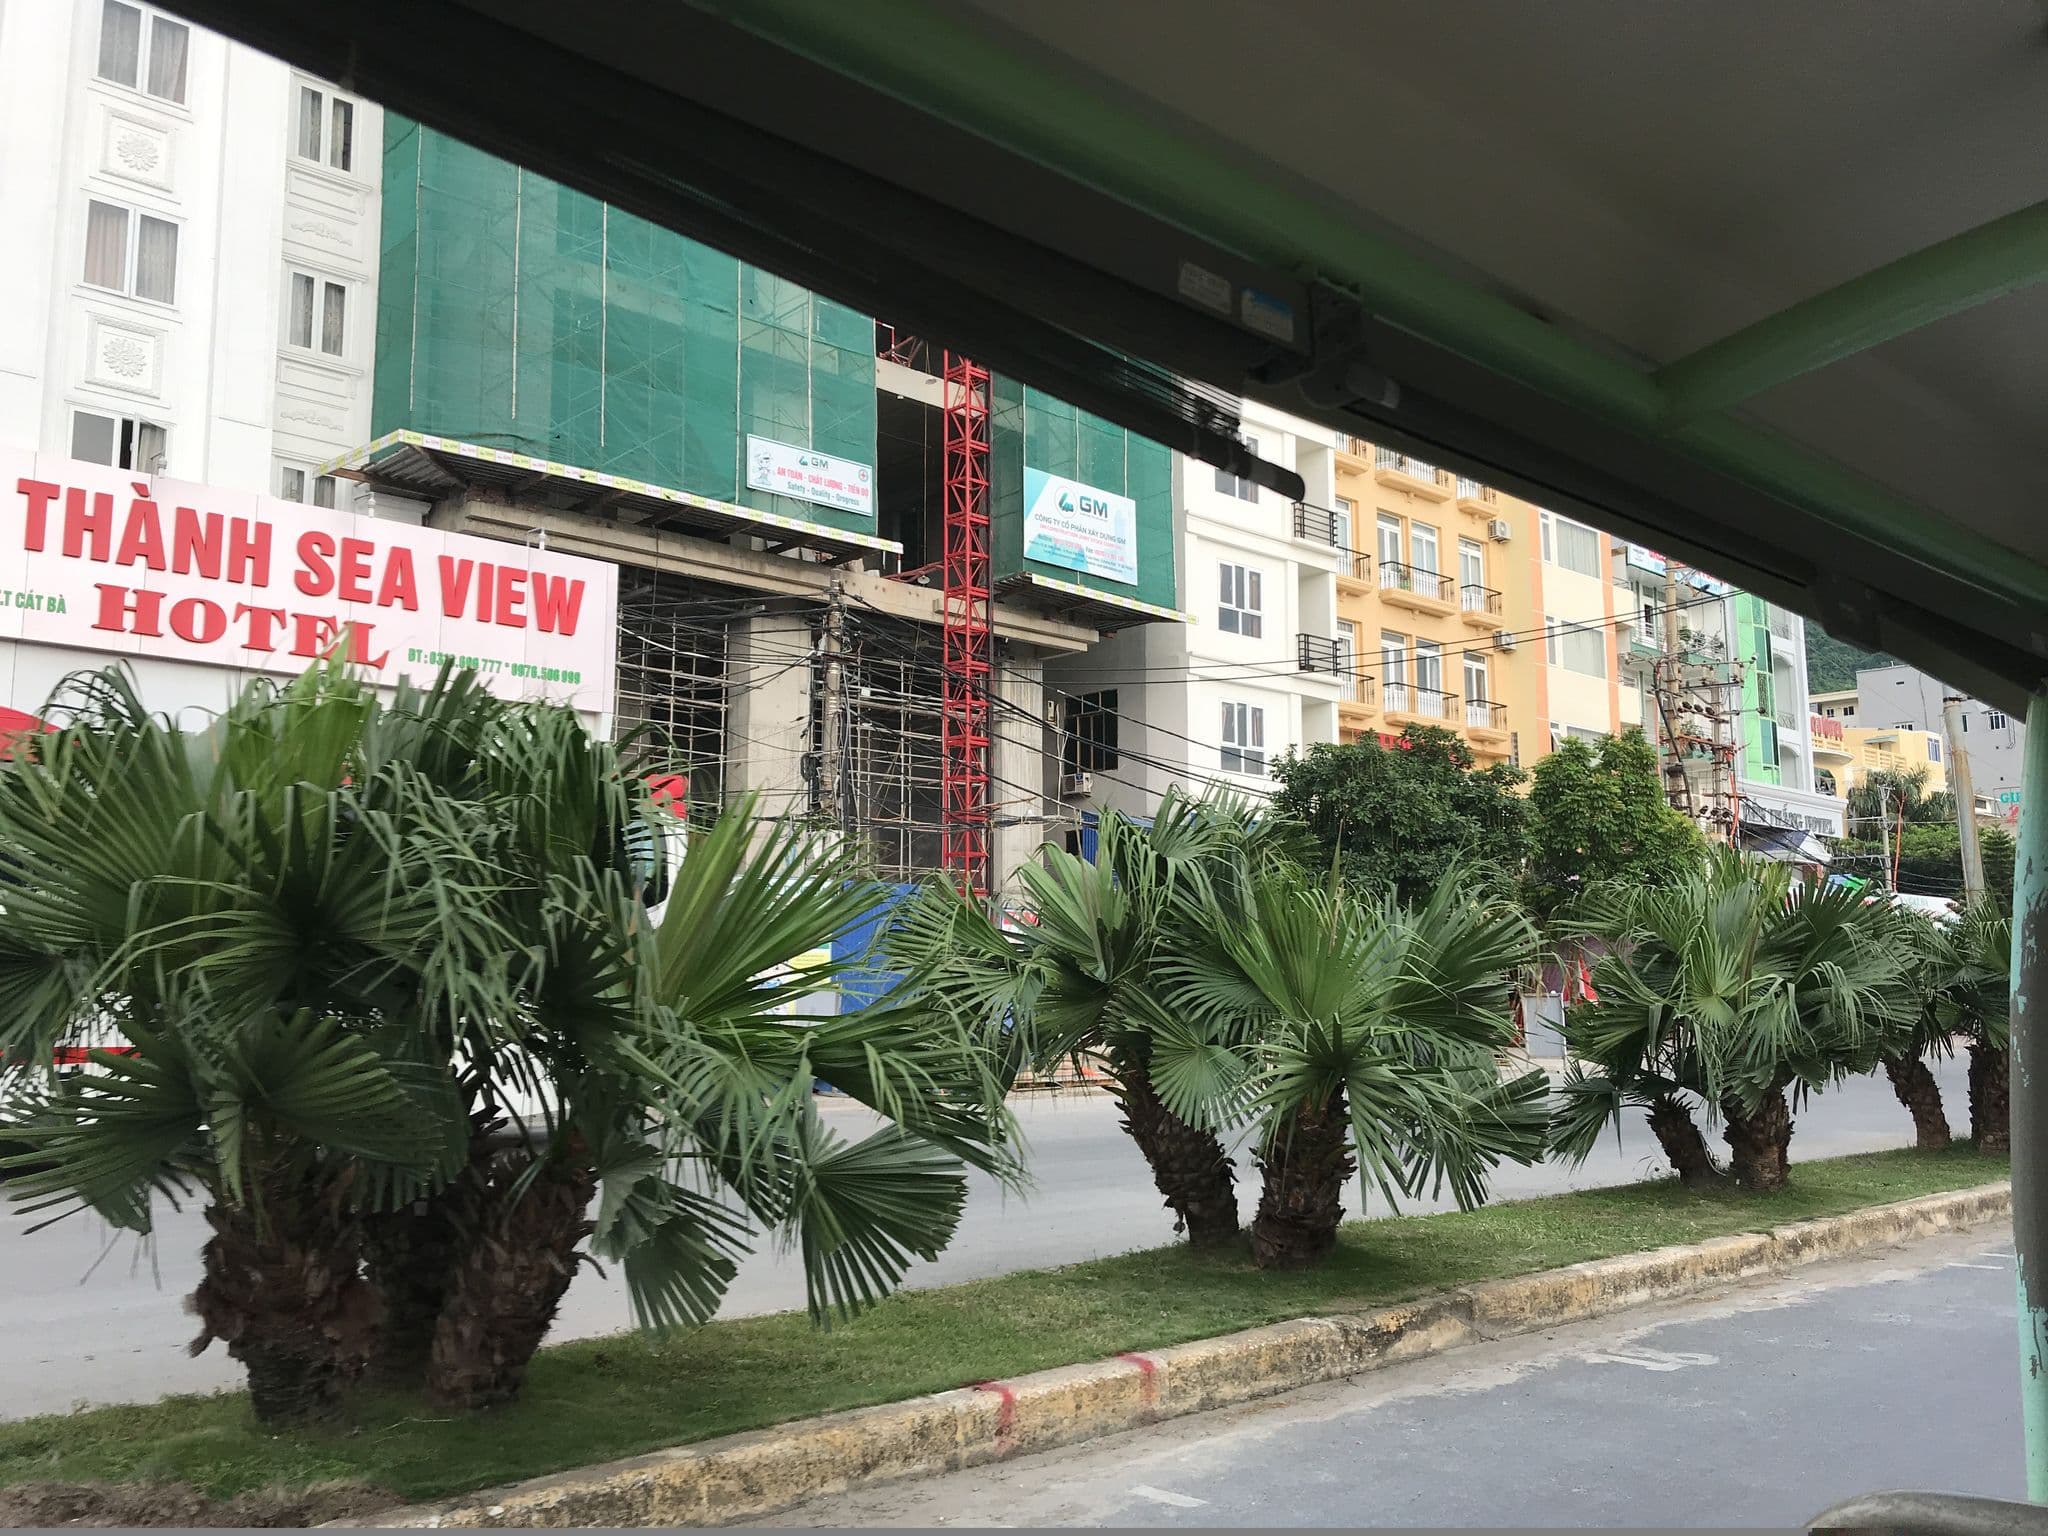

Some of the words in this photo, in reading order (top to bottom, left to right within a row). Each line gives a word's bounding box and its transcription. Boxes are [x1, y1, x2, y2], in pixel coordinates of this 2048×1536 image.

[1079, 495, 1108, 519] GM
[17, 478, 273, 588] THÀNH
[293, 530, 419, 612] SEA
[438, 554, 586, 637] VIEW
[15, 588, 44, 611] CÁT
[46, 593, 67, 614] BÀ
[93, 582, 389, 671] HOTEL
[481, 657, 503, 675] 777
